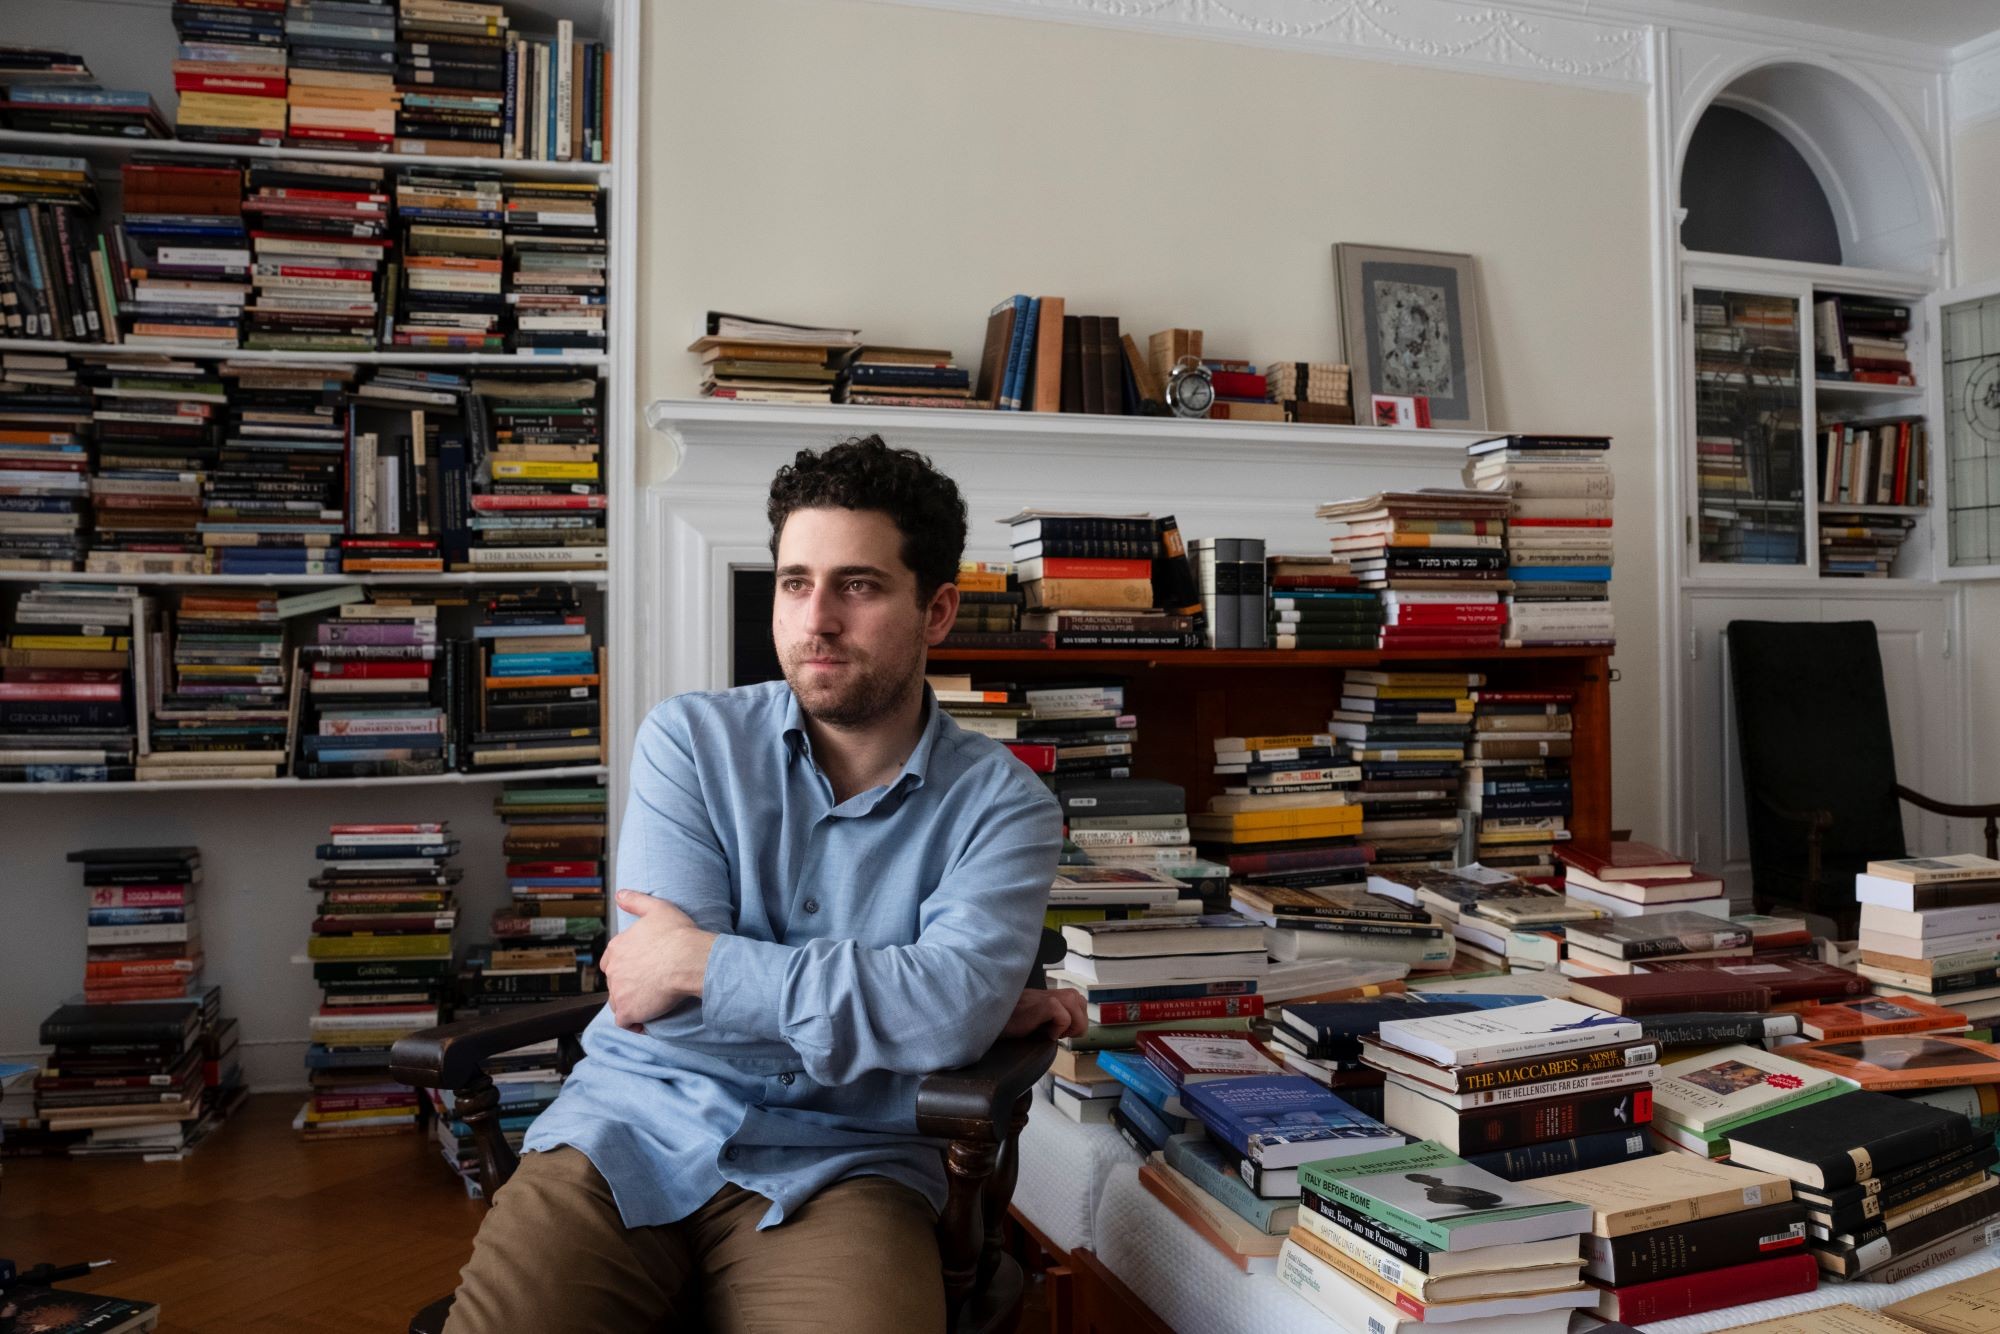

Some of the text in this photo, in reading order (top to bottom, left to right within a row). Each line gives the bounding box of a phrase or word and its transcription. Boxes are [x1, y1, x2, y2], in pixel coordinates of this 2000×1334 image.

[483, 552, 572, 560] THE RUSSIAN ICON
[9, 712, 81, 724] GEOGRAPHY
[350, 725, 392, 733] LEONARDO
[1257, 786, 1272, 794] What
[1284, 785, 1300, 793] Have
[1301, 784, 1333, 792] Happened
[1315, 907, 1358, 918] MANUSCRIPTS
[1358, 910, 1367, 918] OF
[1367, 910, 1380, 918] THE
[1380, 911, 1397, 920] GREEK
[1367, 926, 1392, 934] CENTRAL
[1638, 942, 1655, 953] The
[358, 966, 399, 977] GARDENING
[1146, 1002, 1160, 1010] THE
[1164, 1001, 1196, 1009] ORANGE
[1892, 1022, 1917, 1032] GREAT
[1589, 1050, 1618, 1060] MOSHE
[1466, 1057, 1625, 1089] THE MACCABEES PEARLMAN
[1498, 1089, 1512, 1101] THE
[1513, 1083, 1557, 1098] HELLENISTIC
[1558, 1081, 1571, 1093] FAR
[1572, 1078, 1589, 1091] EAST
[1324, 1153, 1449, 1174] ITALY BEFORE ROME
[1365, 1163, 1439, 1174] SOURCEBOOK
[1304, 1173, 1371, 1210] ITALY BEFORE ROME
[1362, 1250, 1372, 1263] THE
[1886, 1246, 1957, 1284] Cultures of Power
